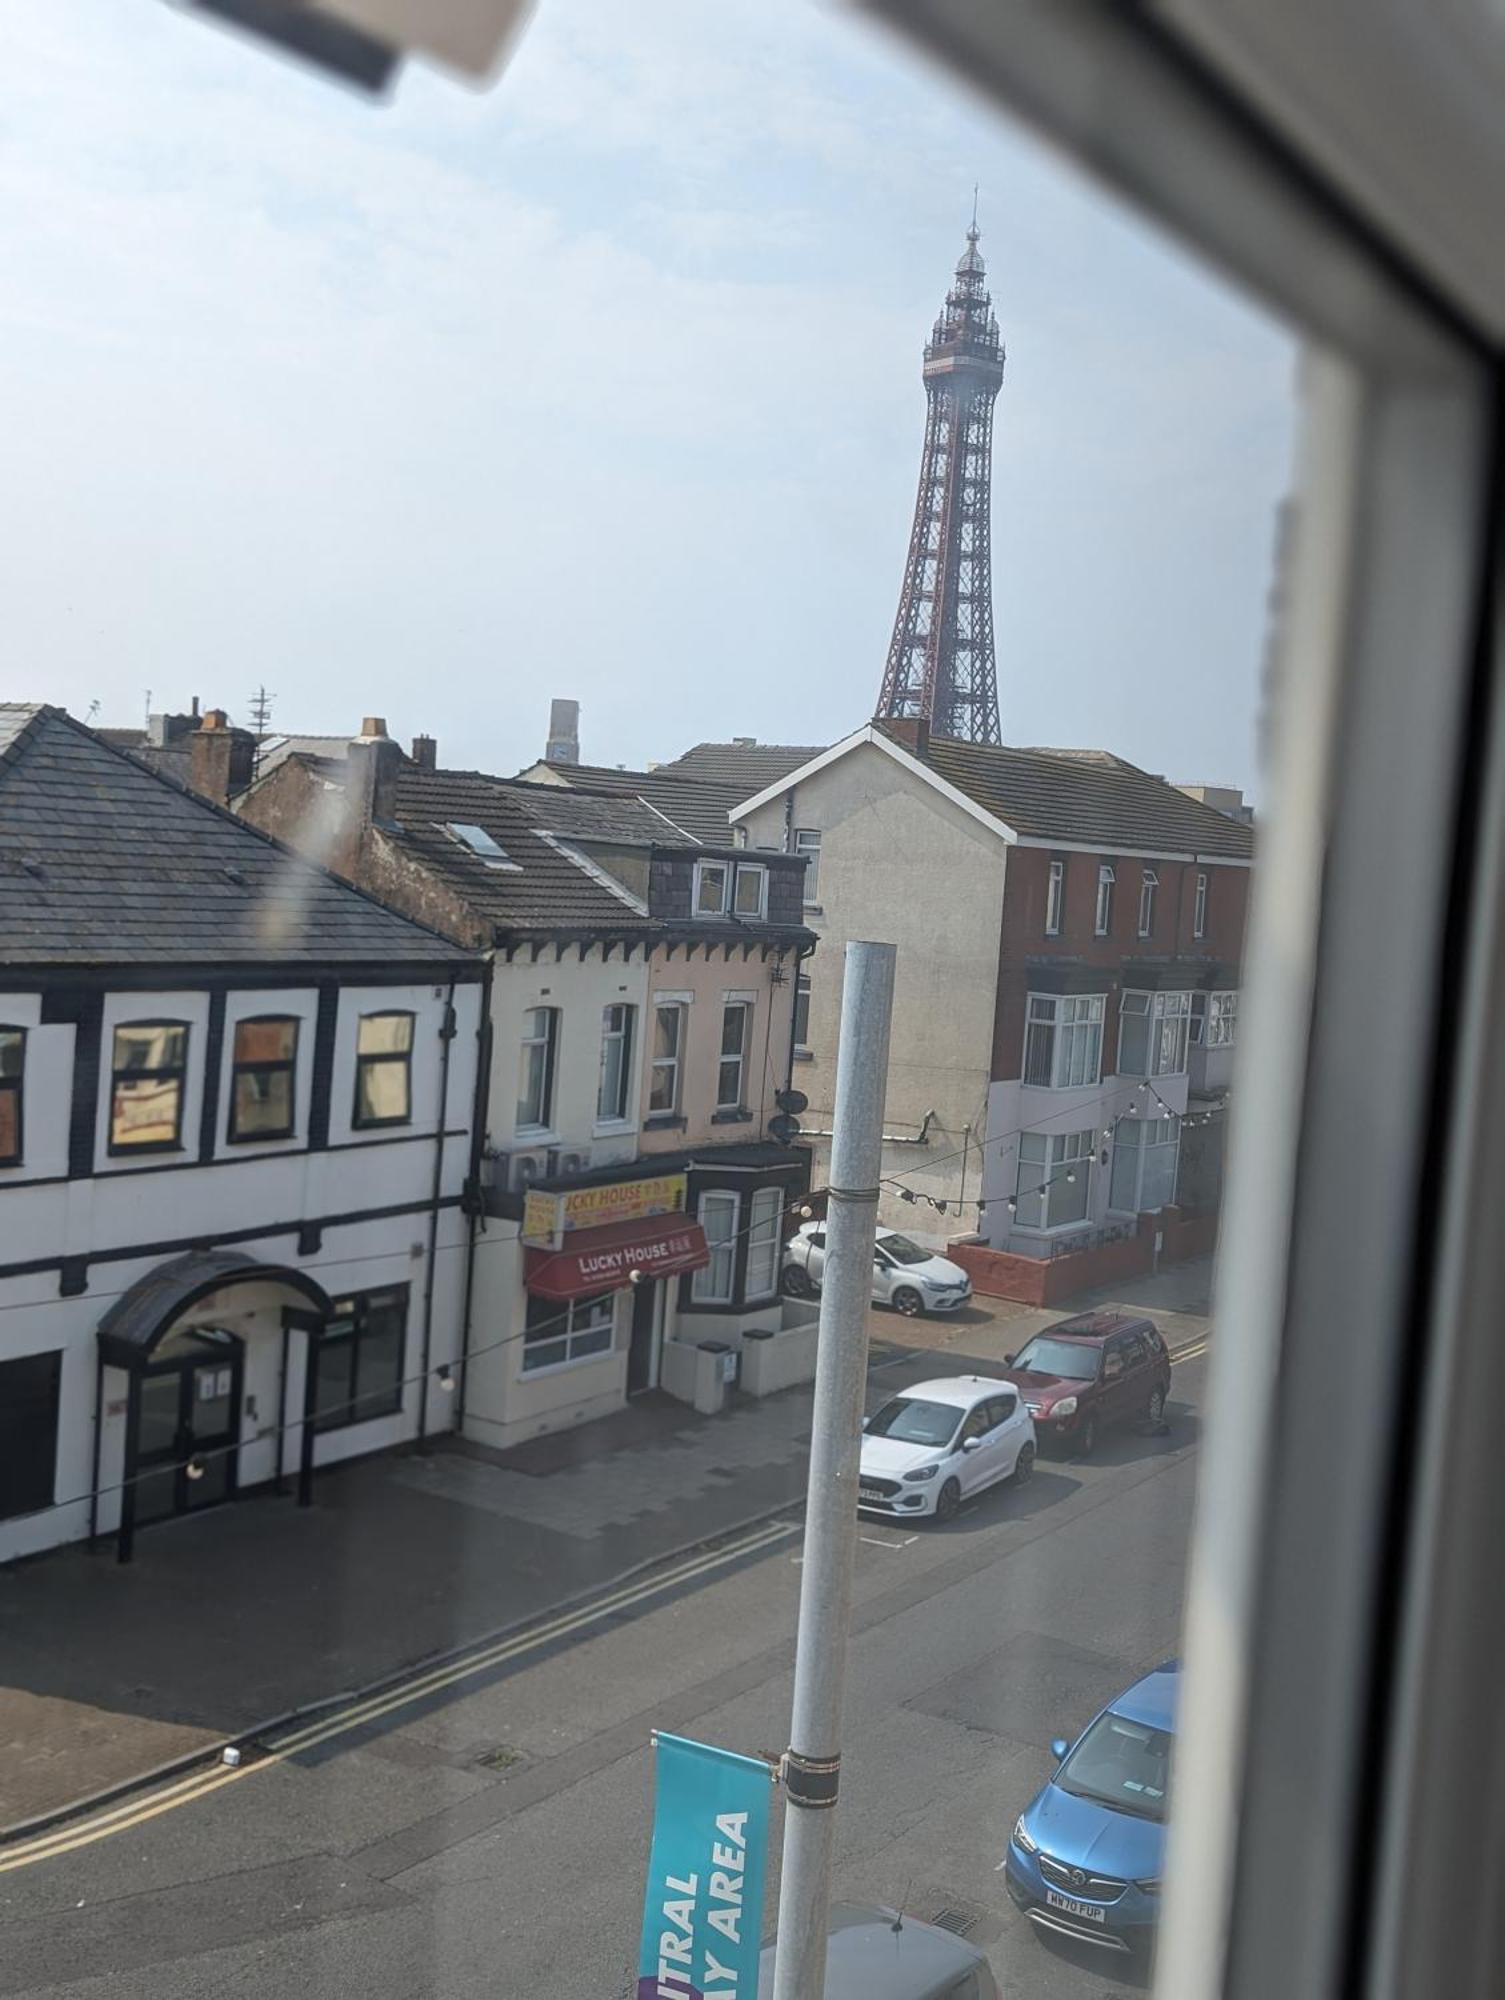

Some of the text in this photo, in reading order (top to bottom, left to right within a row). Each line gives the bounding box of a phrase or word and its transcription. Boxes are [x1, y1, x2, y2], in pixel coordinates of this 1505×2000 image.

[565, 1191, 597, 1212] UCKY
[599, 1184, 641, 1206] HOUSE
[579, 1252, 623, 1273] LUCKY
[624, 1242, 669, 1264] HOUSE
[707, 1811, 748, 1944] AREA
[1079, 1904, 1101, 1918] FUP
